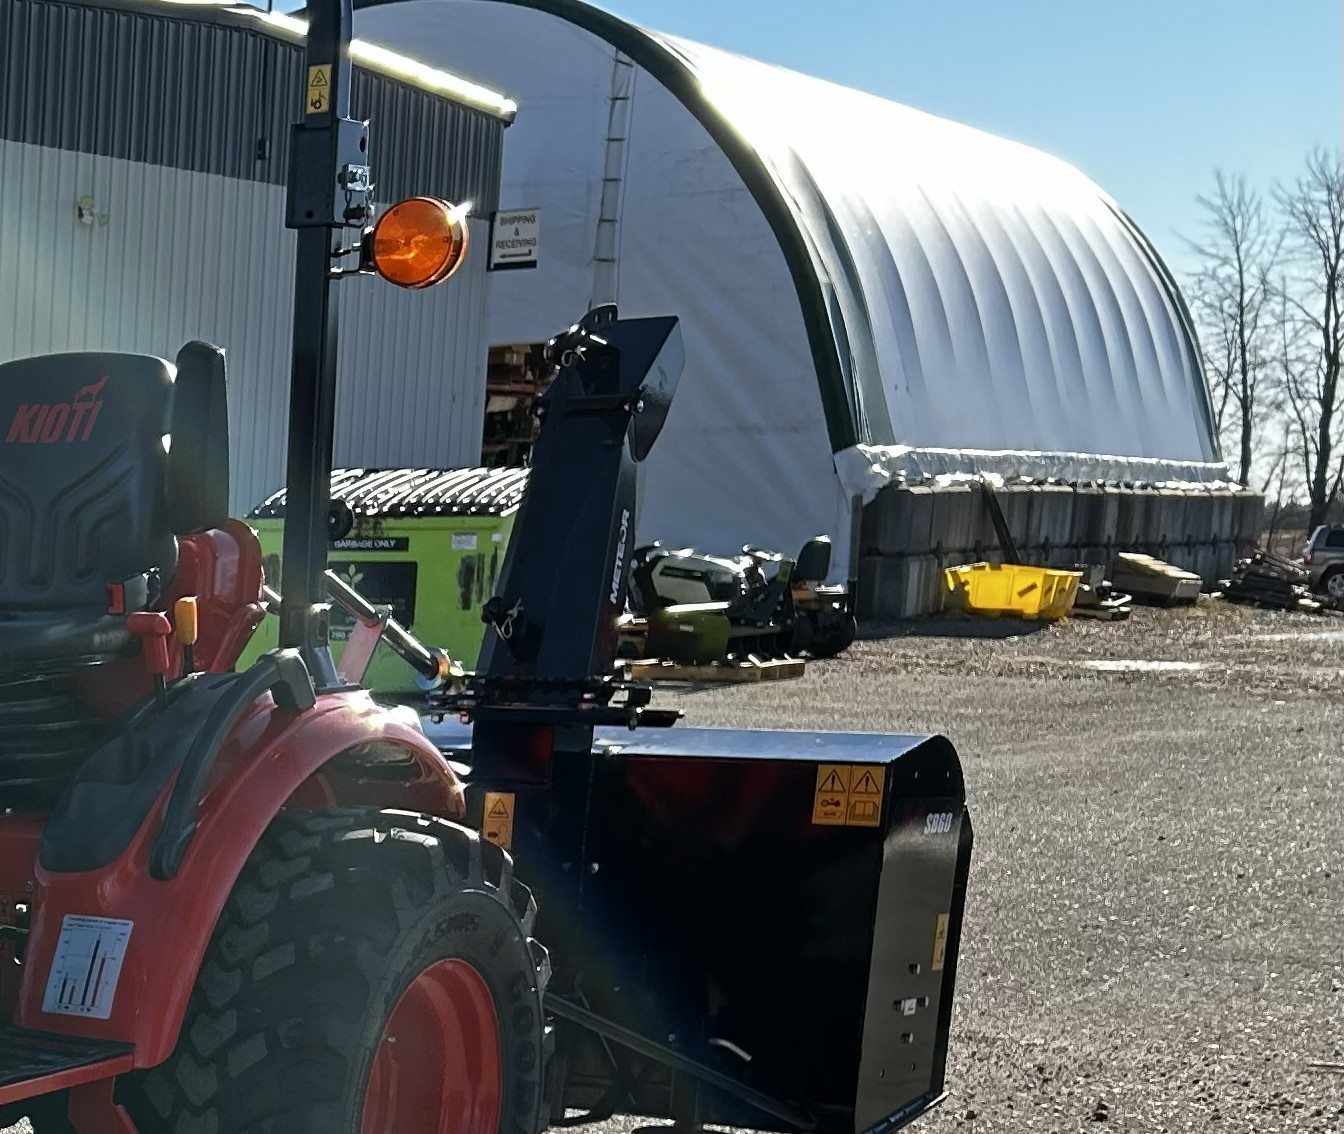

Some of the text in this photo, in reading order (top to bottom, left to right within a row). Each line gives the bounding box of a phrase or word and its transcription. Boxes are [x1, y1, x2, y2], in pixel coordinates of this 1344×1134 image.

[5, 400, 103, 444] KIOTI
[374, 539, 396, 549] ONLY
[610, 508, 630, 605] METEOR
